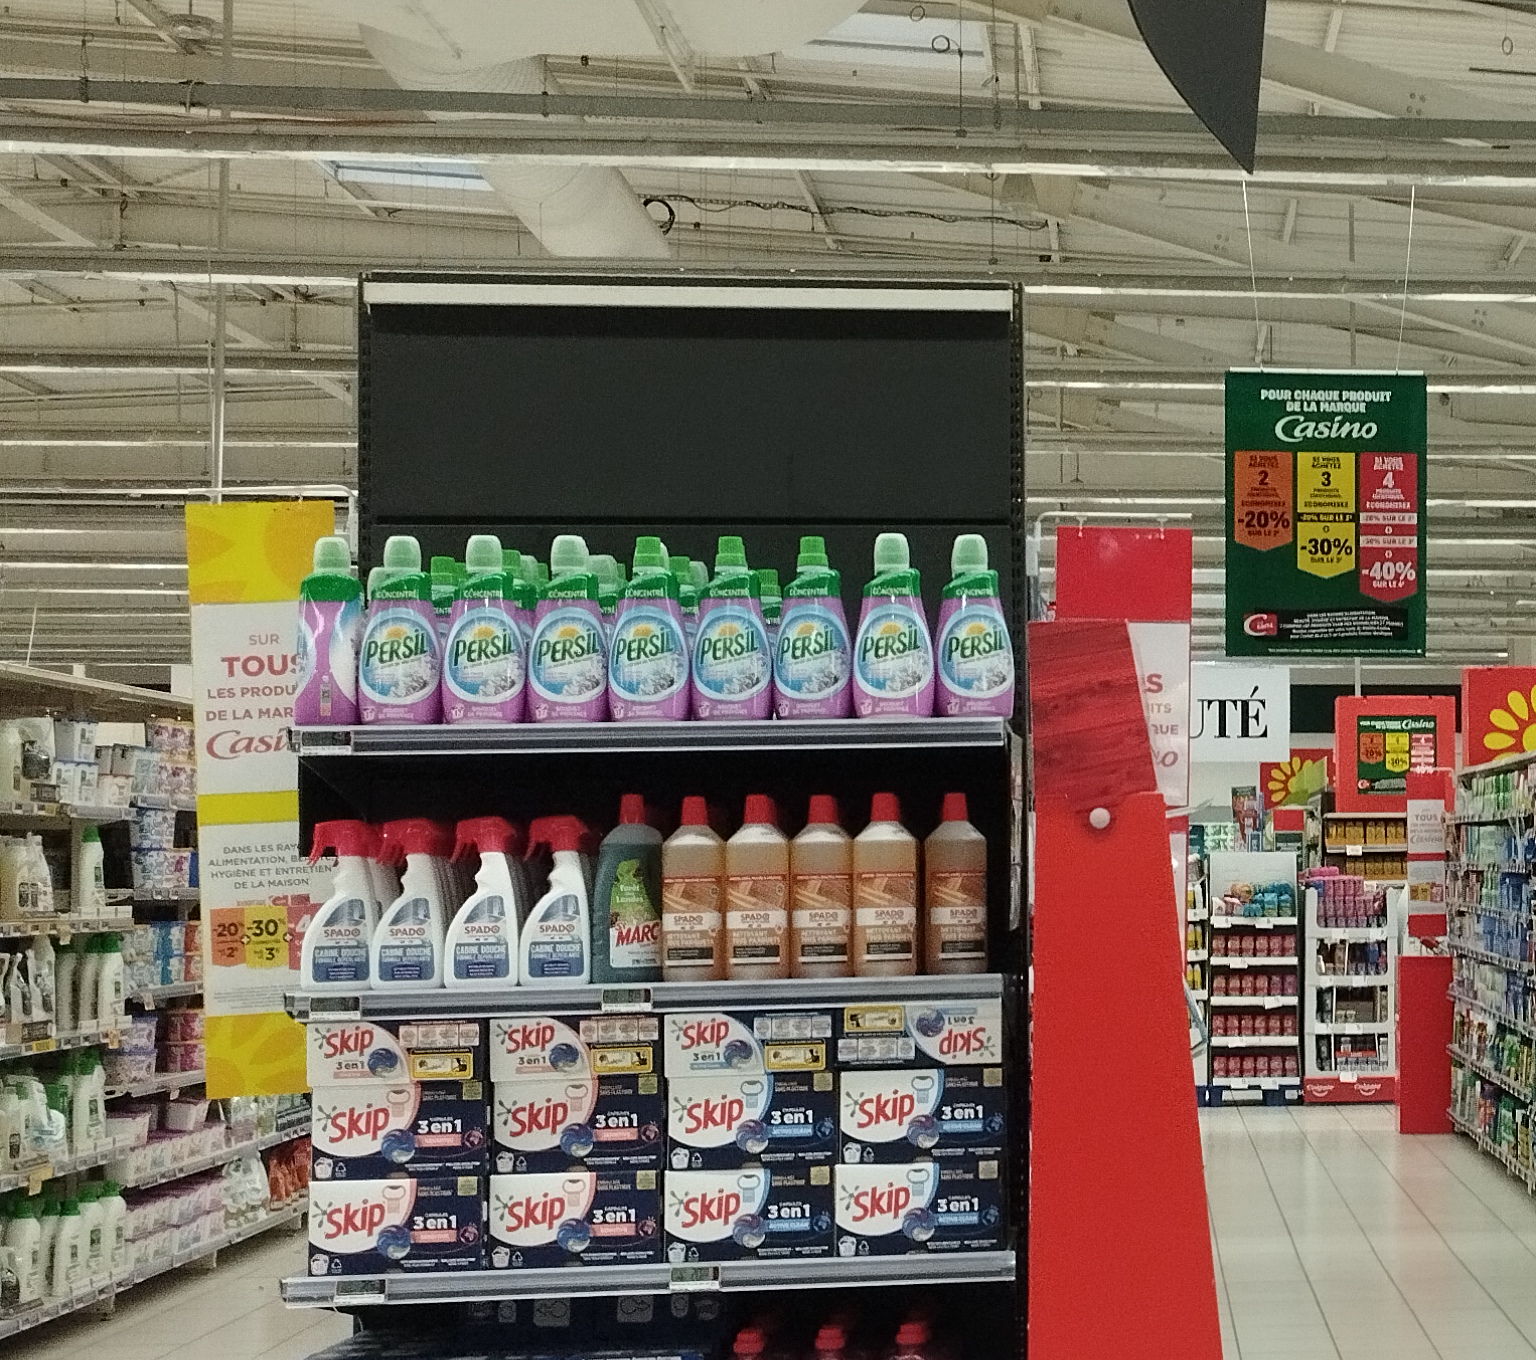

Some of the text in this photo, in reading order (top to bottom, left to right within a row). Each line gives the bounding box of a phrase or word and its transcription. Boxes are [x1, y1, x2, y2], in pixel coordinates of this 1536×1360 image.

[1261, 389, 1392, 402] POUR CHAQUE PRODUIT
[1286, 402, 1366, 413] DE LA MARQUE
[1275, 415, 1377, 442] Casino
[1258, 470, 1269, 485] 2
[1321, 472, 1331, 487] 3
[1382, 472, 1394, 488] 4
[1238, 511, 1290, 529] -20%
[1300, 538, 1353, 555] -30%
[1362, 562, 1416, 581] -40%
[249, 633, 280, 645] SUR
[207, 684, 297, 699] LES PRODU
[206, 707, 293, 721] DE LA MAR
[1189, 686, 1268, 739] UTÉ
[206, 727, 288, 760] Casi
[223, 845, 252, 854] DANS
[268, 878, 309, 888] MAISON
[324, 927, 360, 937] SPADO
[390, 926, 425, 936] SPADO
[465, 924, 499, 934] SPADO
[540, 923, 574, 932] SPADO
[616, 922, 660, 948] MARC
[324, 1025, 374, 1059] Skip
[506, 1021, 555, 1053] Skip
[681, 1019, 729, 1049] Skip
[685, 1094, 744, 1133] Skip
[857, 1089, 915, 1129] Skip
[329, 1103, 390, 1143] Skip
[510, 1098, 568, 1138] Skip
[325, 1199, 385, 1240] Skip
[506, 1192, 565, 1232] Skip
